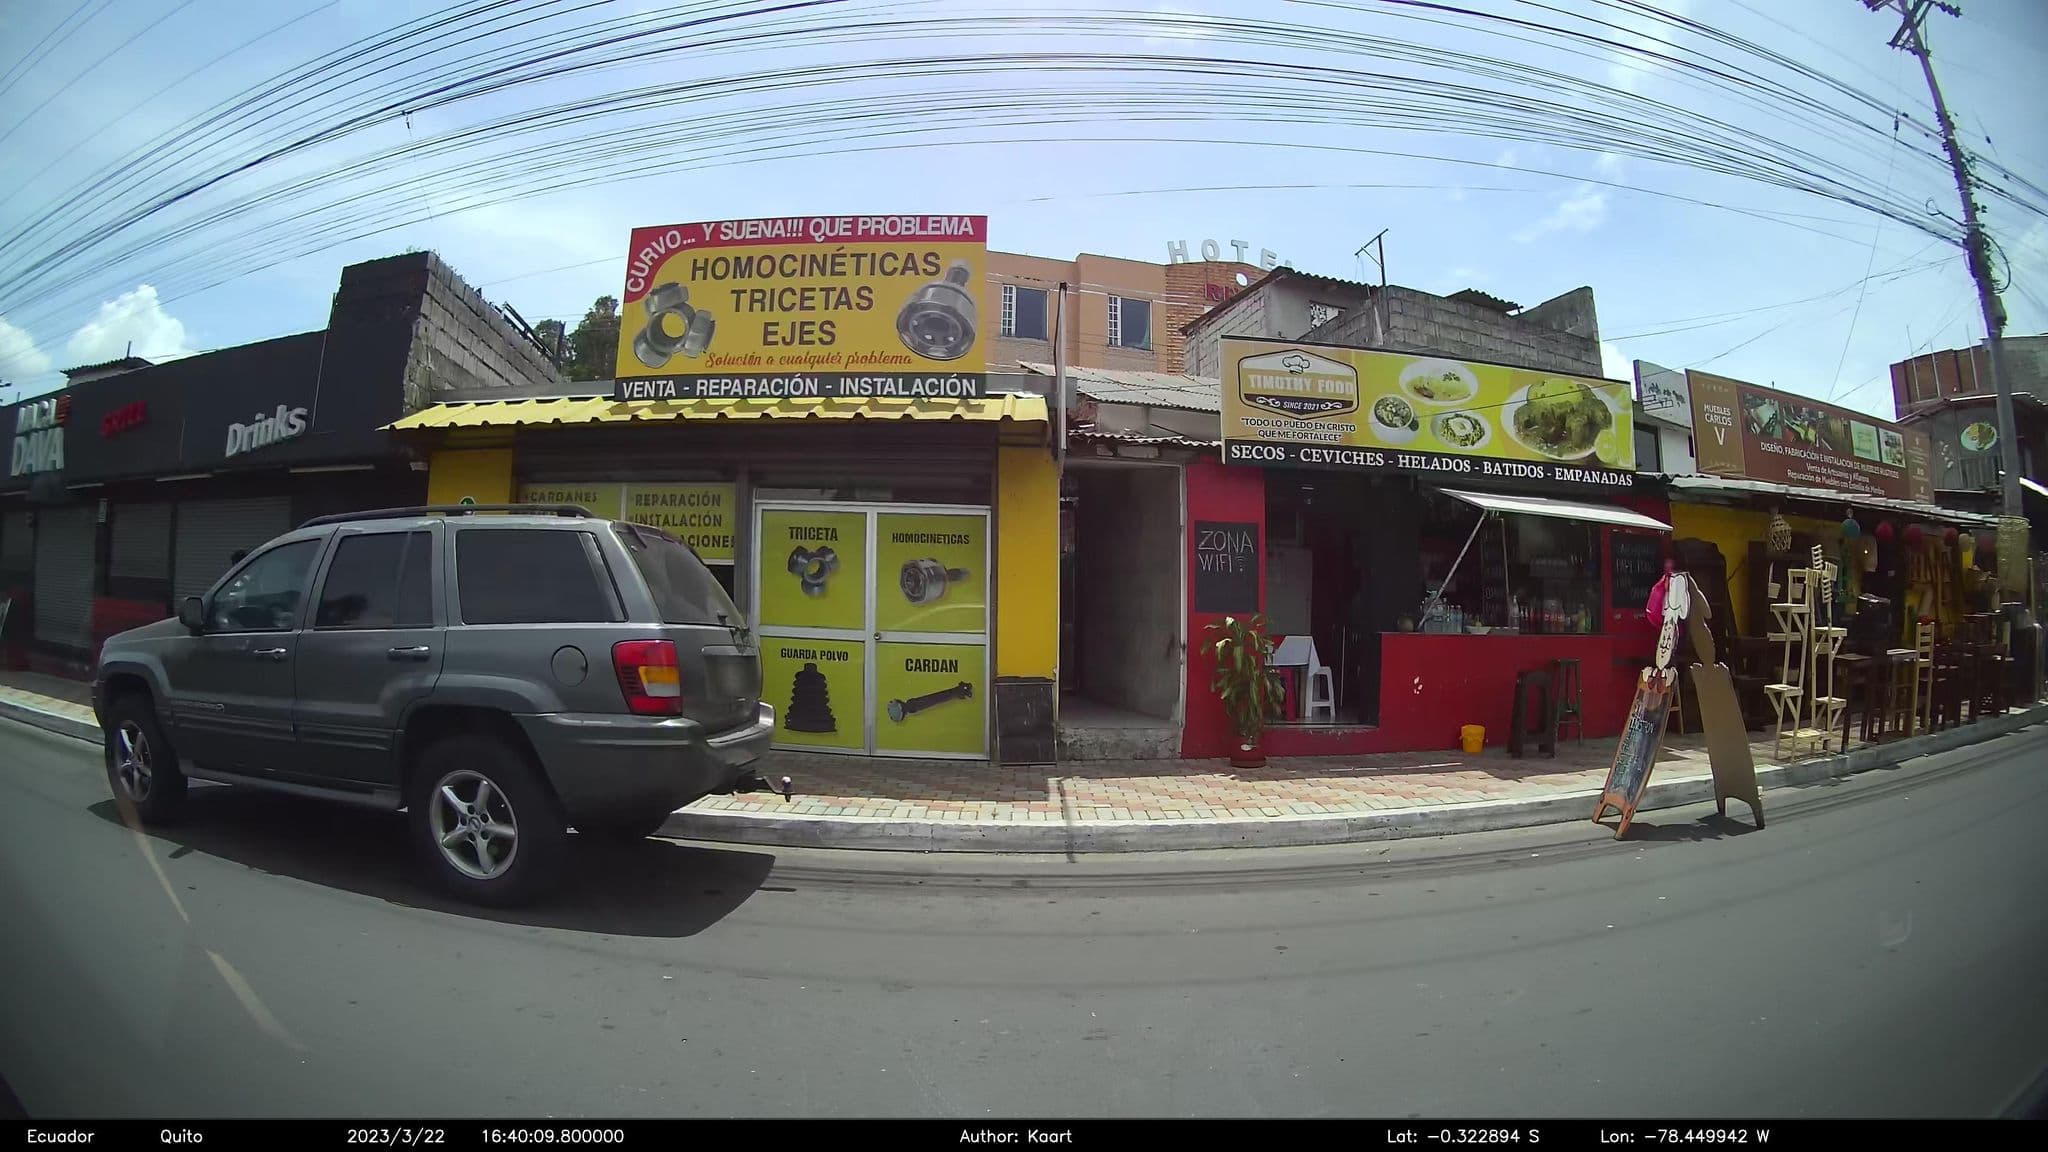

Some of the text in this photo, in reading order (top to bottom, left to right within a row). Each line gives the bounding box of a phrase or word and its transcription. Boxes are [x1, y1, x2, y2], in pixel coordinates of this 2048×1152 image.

[702, 215, 975, 243] Y SUENA!!! QUE PROBLEMA
[626, 230, 696, 293] CURVO...
[691, 246, 941, 282] HOMOCINÉTICAS
[731, 285, 874, 313] TRICETAS
[763, 320, 836, 346] EJES
[705, 350, 912, 369] Solución a cualquier problema
[623, 378, 676, 399] VENTA
[696, 375, 818, 397] REPARACIÓN
[839, 374, 976, 398] INSTALACIÓN
[1248, 375, 1354, 394] TIMOTHY FOOD
[1283, 401, 1319, 411] SINCE 2021
[1703, 403, 1731, 416] MUEBLES
[1271, 419, 1282, 428] LO
[1284, 420, 1313, 430] PUEDO
[1315, 422, 1325, 431] EN
[1327, 423, 1356, 432] CRISTO
[1704, 413, 1732, 427] CARLOS
[225, 404, 307, 458] Drinks
[1258, 430, 1277, 439] QUE
[1278, 431, 1291, 439] ME
[1714, 426, 1725, 446] V
[1231, 445, 1286, 461] SECOS
[1300, 448, 1384, 467] CEVICHES
[1397, 454, 1471, 474] HELADOS
[1483, 461, 1544, 479] BATIDOS
[1555, 467, 1633, 487] EMPANADAS
[530, 490, 597, 503] CARDANES
[635, 491, 721, 507] REPARACIÓN
[635, 511, 722, 527] INSTALACIÓN
[788, 526, 838, 542] TRICETA
[892, 532, 970, 545] HOMOCINETICAS
[1198, 530, 1254, 554] ZONA
[1198, 553, 1232, 573] WIFI
[780, 647, 849, 662] GUARDA POLVO
[905, 658, 958, 674] CARDAN
